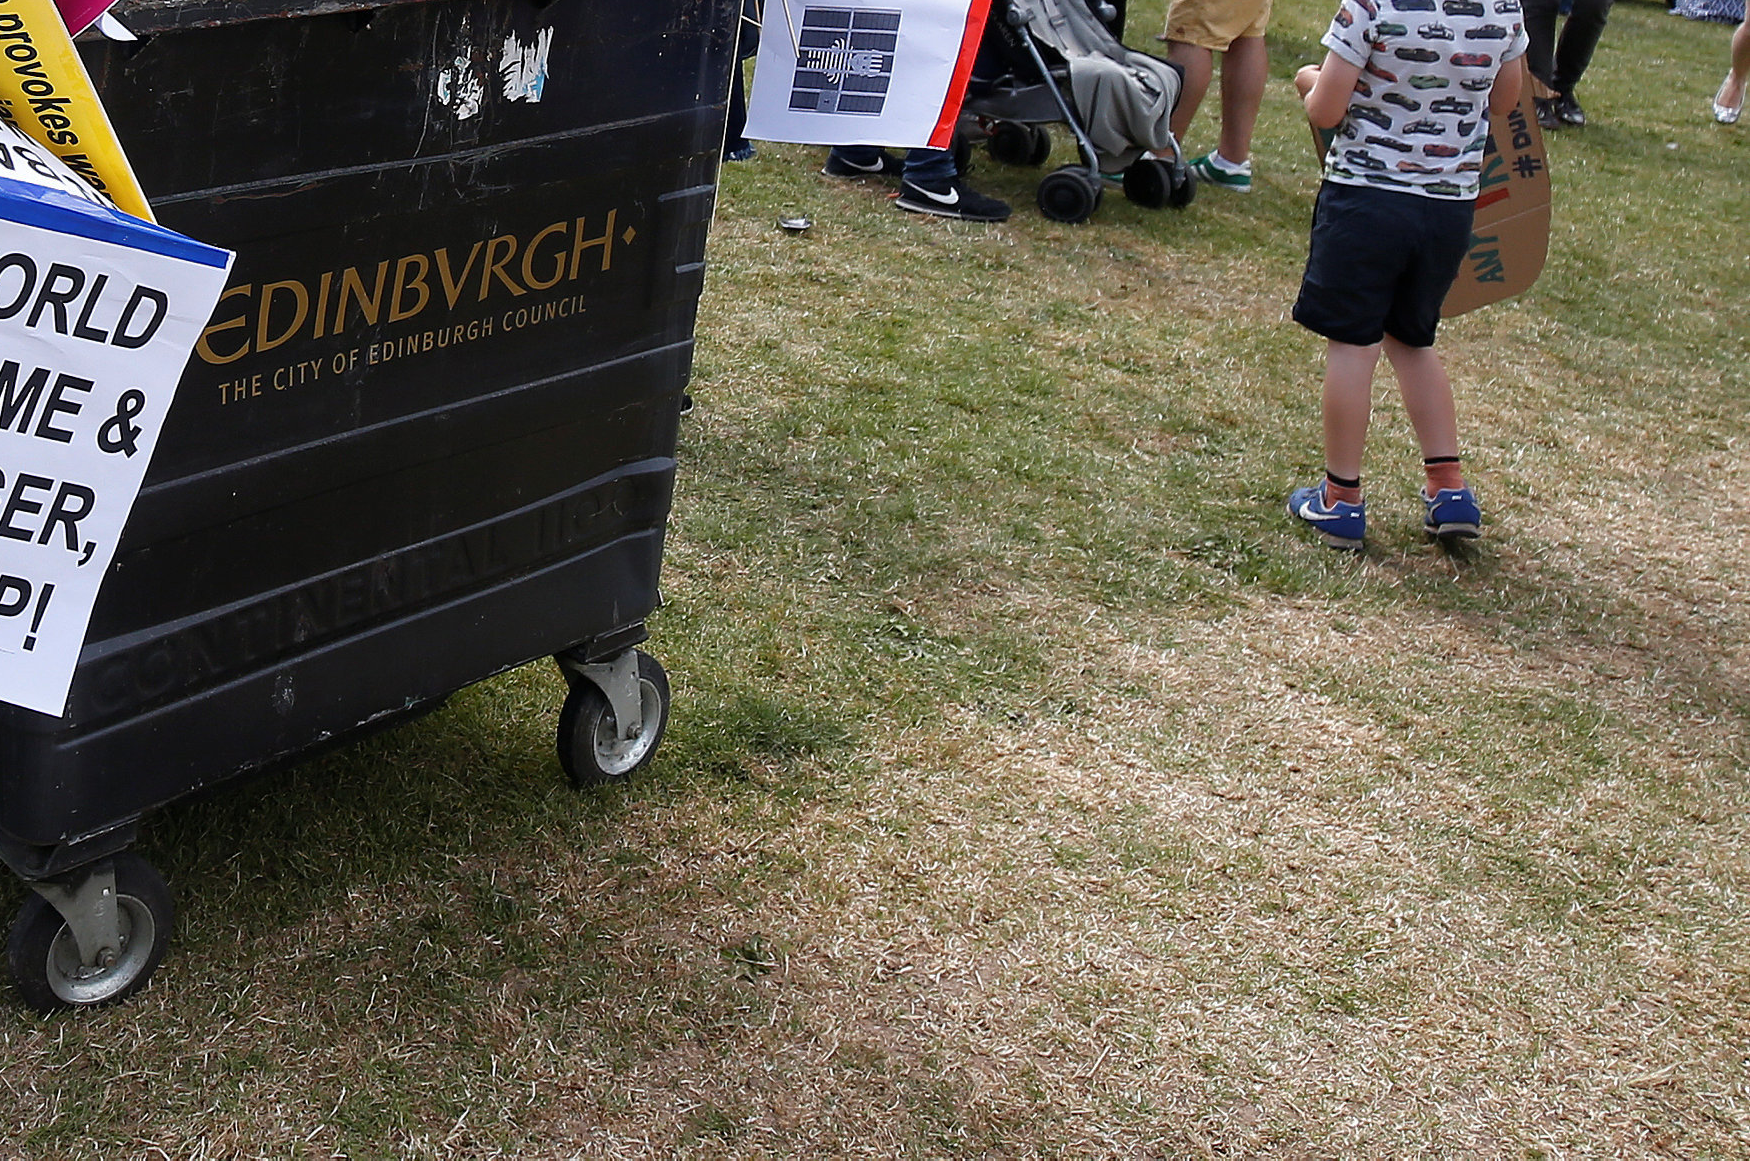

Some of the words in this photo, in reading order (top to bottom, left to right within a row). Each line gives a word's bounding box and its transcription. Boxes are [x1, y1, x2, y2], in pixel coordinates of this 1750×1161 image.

[1469, 235, 1505, 283] ANY
[218, 374, 262, 405] THE
[273, 357, 322, 392] CITY
[332, 348, 359, 375] OF
[368, 317, 494, 365] EDINBURGH
[502, 294, 588, 333] COUNCIL
[97, 388, 146, 459] &
